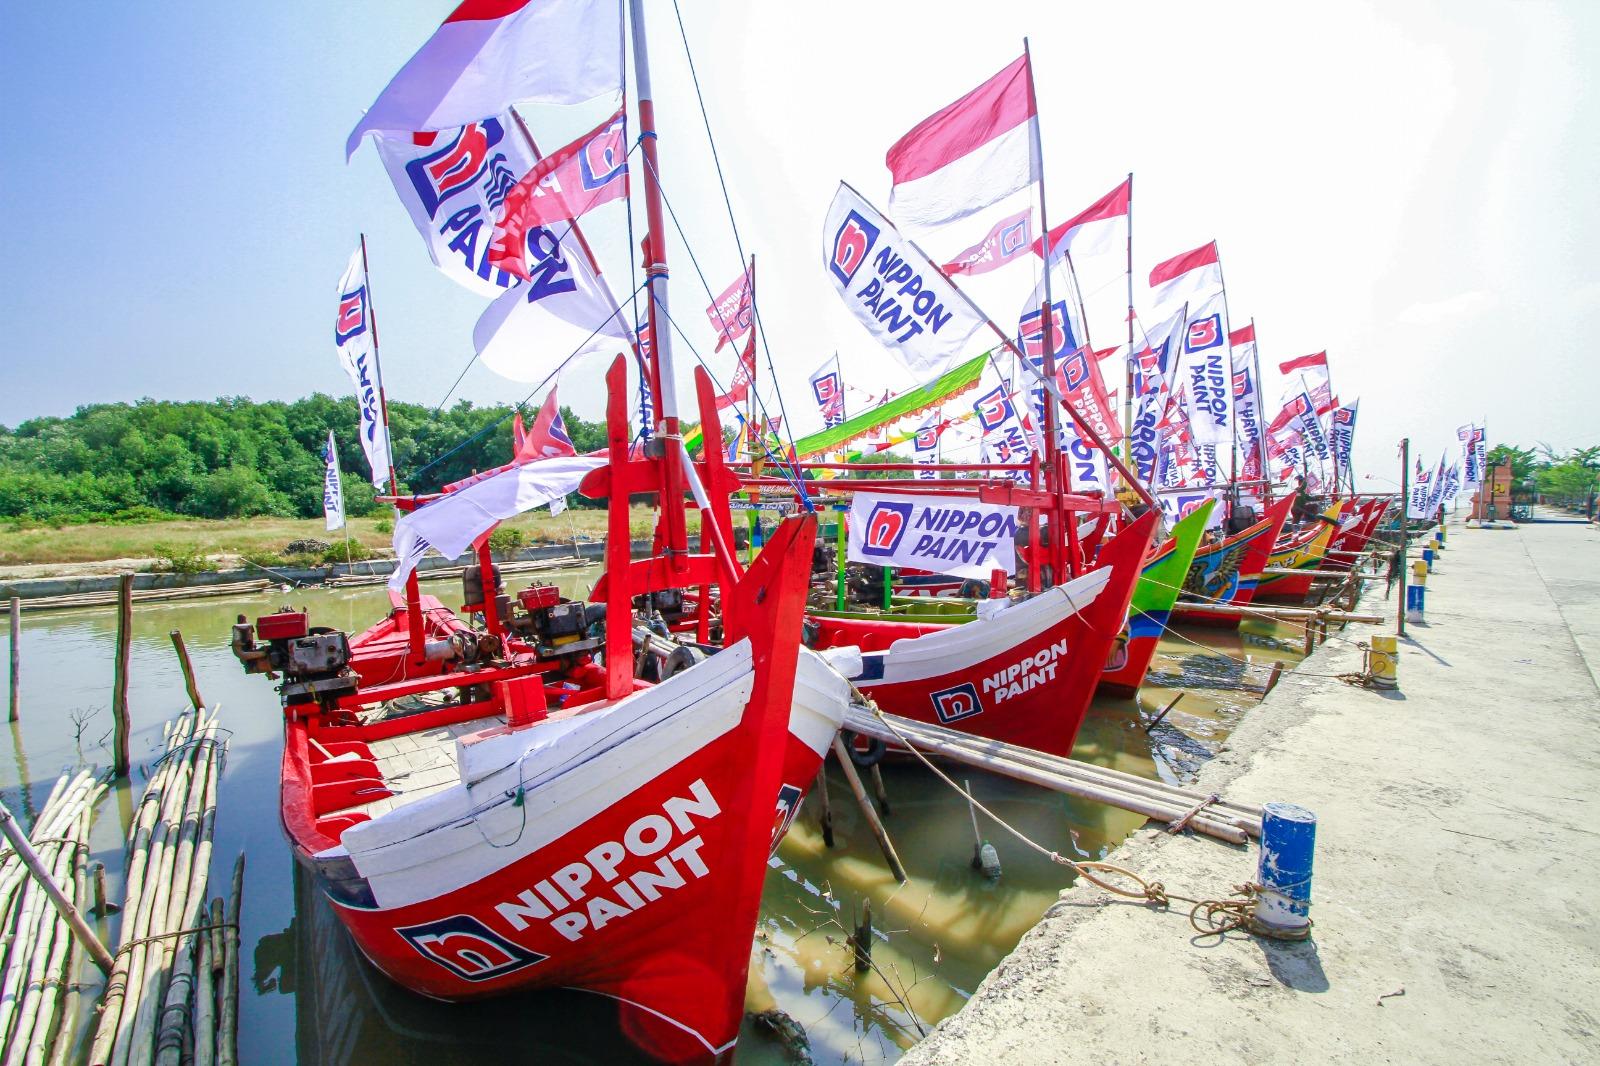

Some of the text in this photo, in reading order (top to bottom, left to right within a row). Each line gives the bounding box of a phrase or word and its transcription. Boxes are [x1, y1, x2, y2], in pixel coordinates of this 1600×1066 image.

[856, 277, 923, 343] PAINT
[873, 245, 953, 334] NIPPON
[1081, 386, 1114, 446] NIPPON
[1190, 364, 1213, 415] PAINT
[1207, 355, 1227, 427] NIPPON
[1304, 417, 1330, 461] NIPPON
[914, 506, 1018, 539] NIPPON
[1411, 487, 1420, 508] PAINT
[1418, 485, 1428, 512] NIPPON
[910, 534, 998, 567] PAINT
[983, 638, 1068, 694] NIPPON
[995, 661, 1058, 705] PAINT
[494, 778, 722, 932] NIPPON
[550, 834, 710, 942] PAINT
